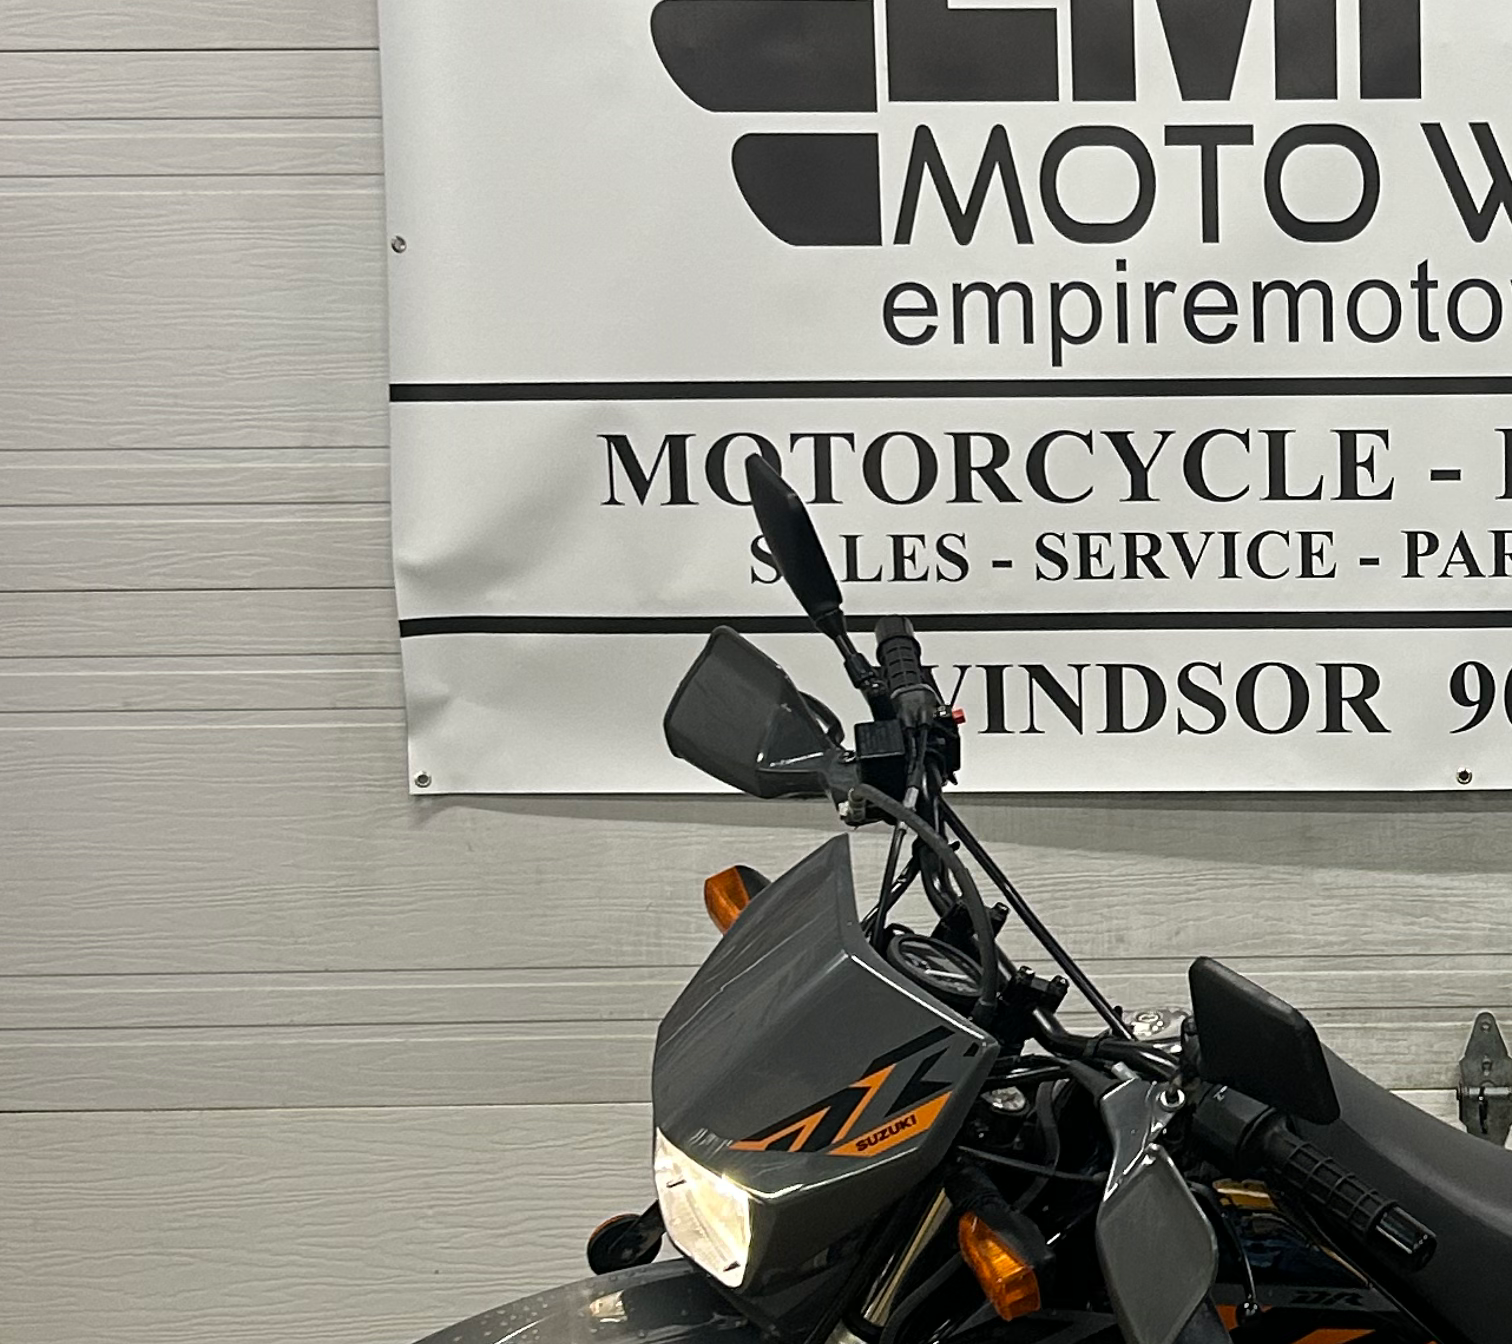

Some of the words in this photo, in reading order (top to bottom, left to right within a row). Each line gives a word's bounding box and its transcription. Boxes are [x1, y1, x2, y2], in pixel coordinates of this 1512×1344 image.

[893, 123, 1381, 246] MOTO
[597, 428, 1395, 507] MOTORCYCLE
[1430, 469, 1462, 482] -
[750, 532, 969, 584] SLES
[1035, 530, 1337, 582] SERVICE
[855, 1114, 917, 1152] SUZUKI
